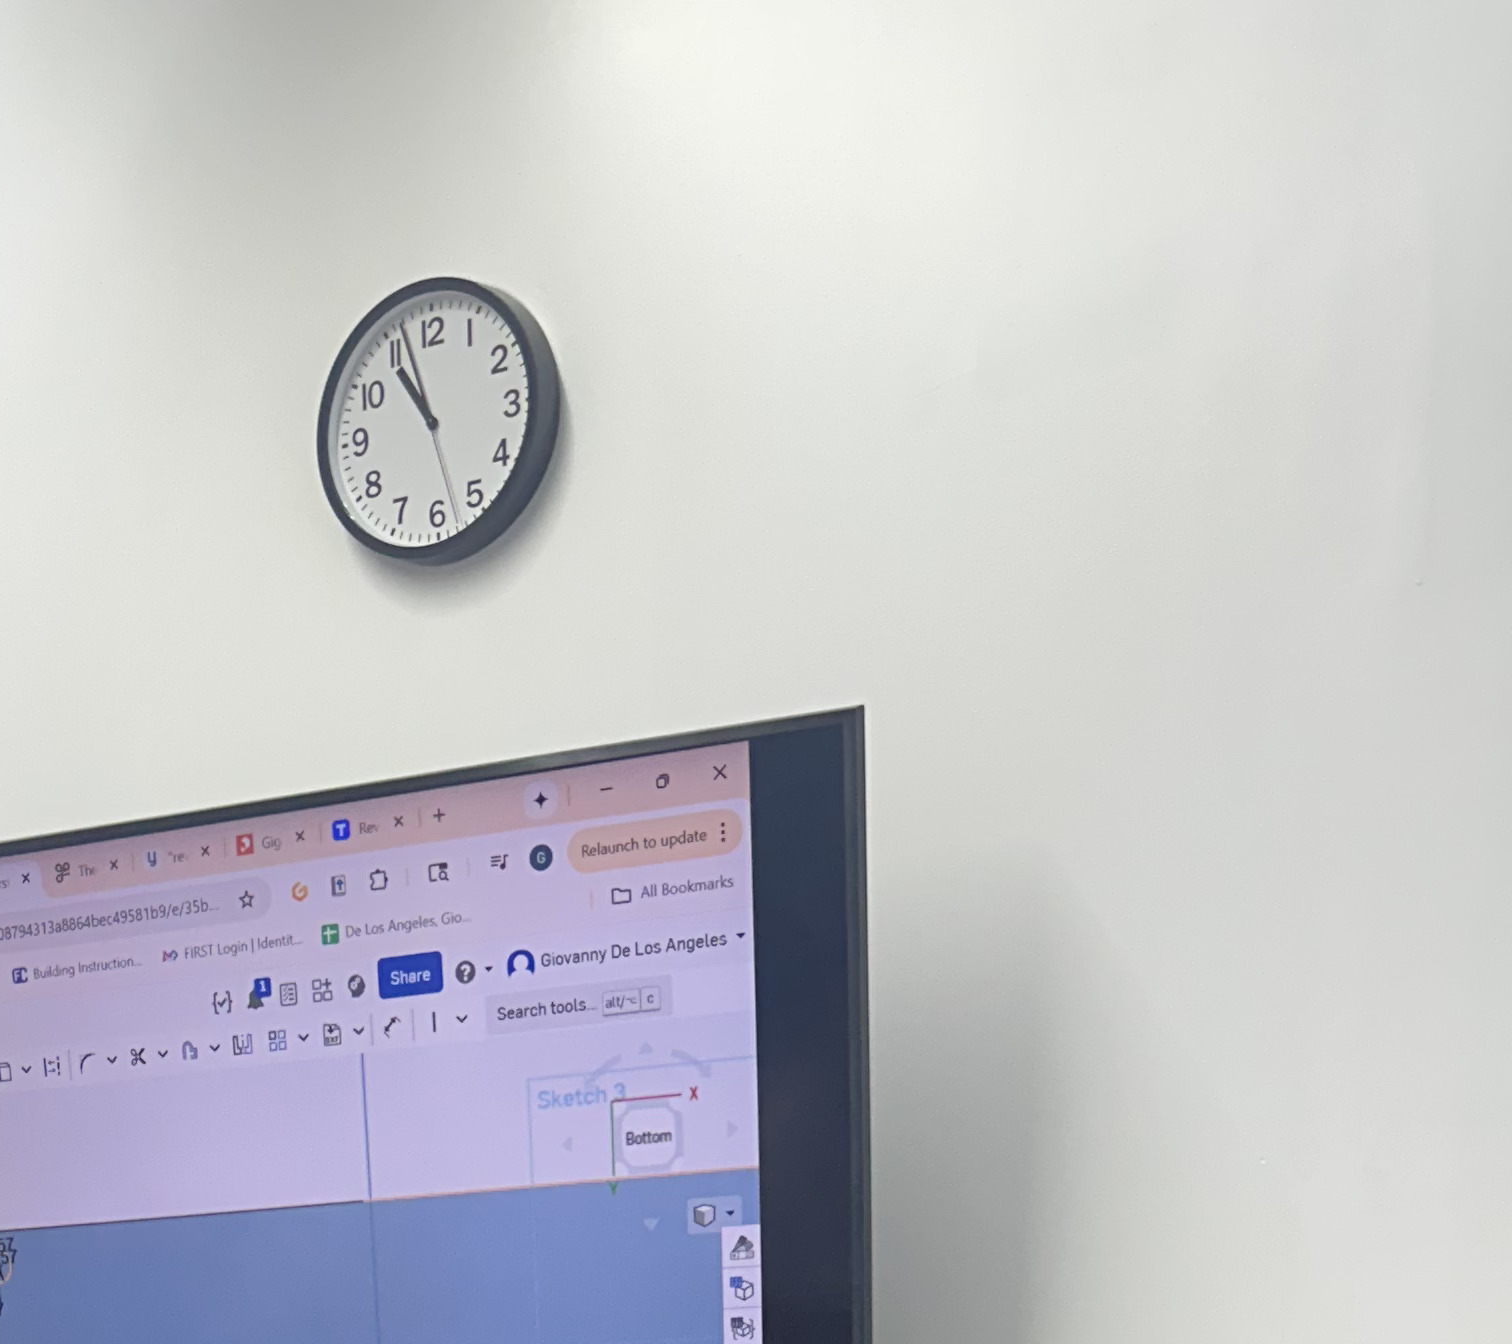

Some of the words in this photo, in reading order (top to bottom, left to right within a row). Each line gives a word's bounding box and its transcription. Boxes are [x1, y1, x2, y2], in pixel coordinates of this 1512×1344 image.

[421, 317, 444, 348] 12
[467, 318, 473, 347] 1
[390, 338, 401, 369] 11
[490, 344, 508, 375] 2
[362, 380, 385, 411] 10
[503, 389, 520, 418] 3
[352, 427, 369, 457] 9
[492, 438, 510, 467] 4
[365, 470, 382, 498] 8
[466, 479, 484, 508] 5
[392, 496, 409, 525] 7
[429, 500, 445, 528] 6
[581, 837, 639, 858] Relaunch
[643, 834, 657, 849] to
[661, 829, 708, 848] update
[641, 884, 658, 899] All
[662, 875, 734, 897] Bookmarks
[345, 923, 361, 938] De
[365, 920, 384, 935] Los
[184, 943, 214, 960] FIRST
[217, 941, 248, 957] Login
[541, 948, 607, 968] Giovanny
[611, 944, 630, 958] De
[635, 940, 661, 957] Los
[666, 933, 727, 954] Angeles
[33, 965, 75, 981] Building
[390, 966, 431, 985] Share
[497, 1002, 547, 1021] Search
[537, 1086, 607, 1109] Sketch
[614, 1082, 627, 1099] 3
[625, 1130, 672, 1146] Bottom
